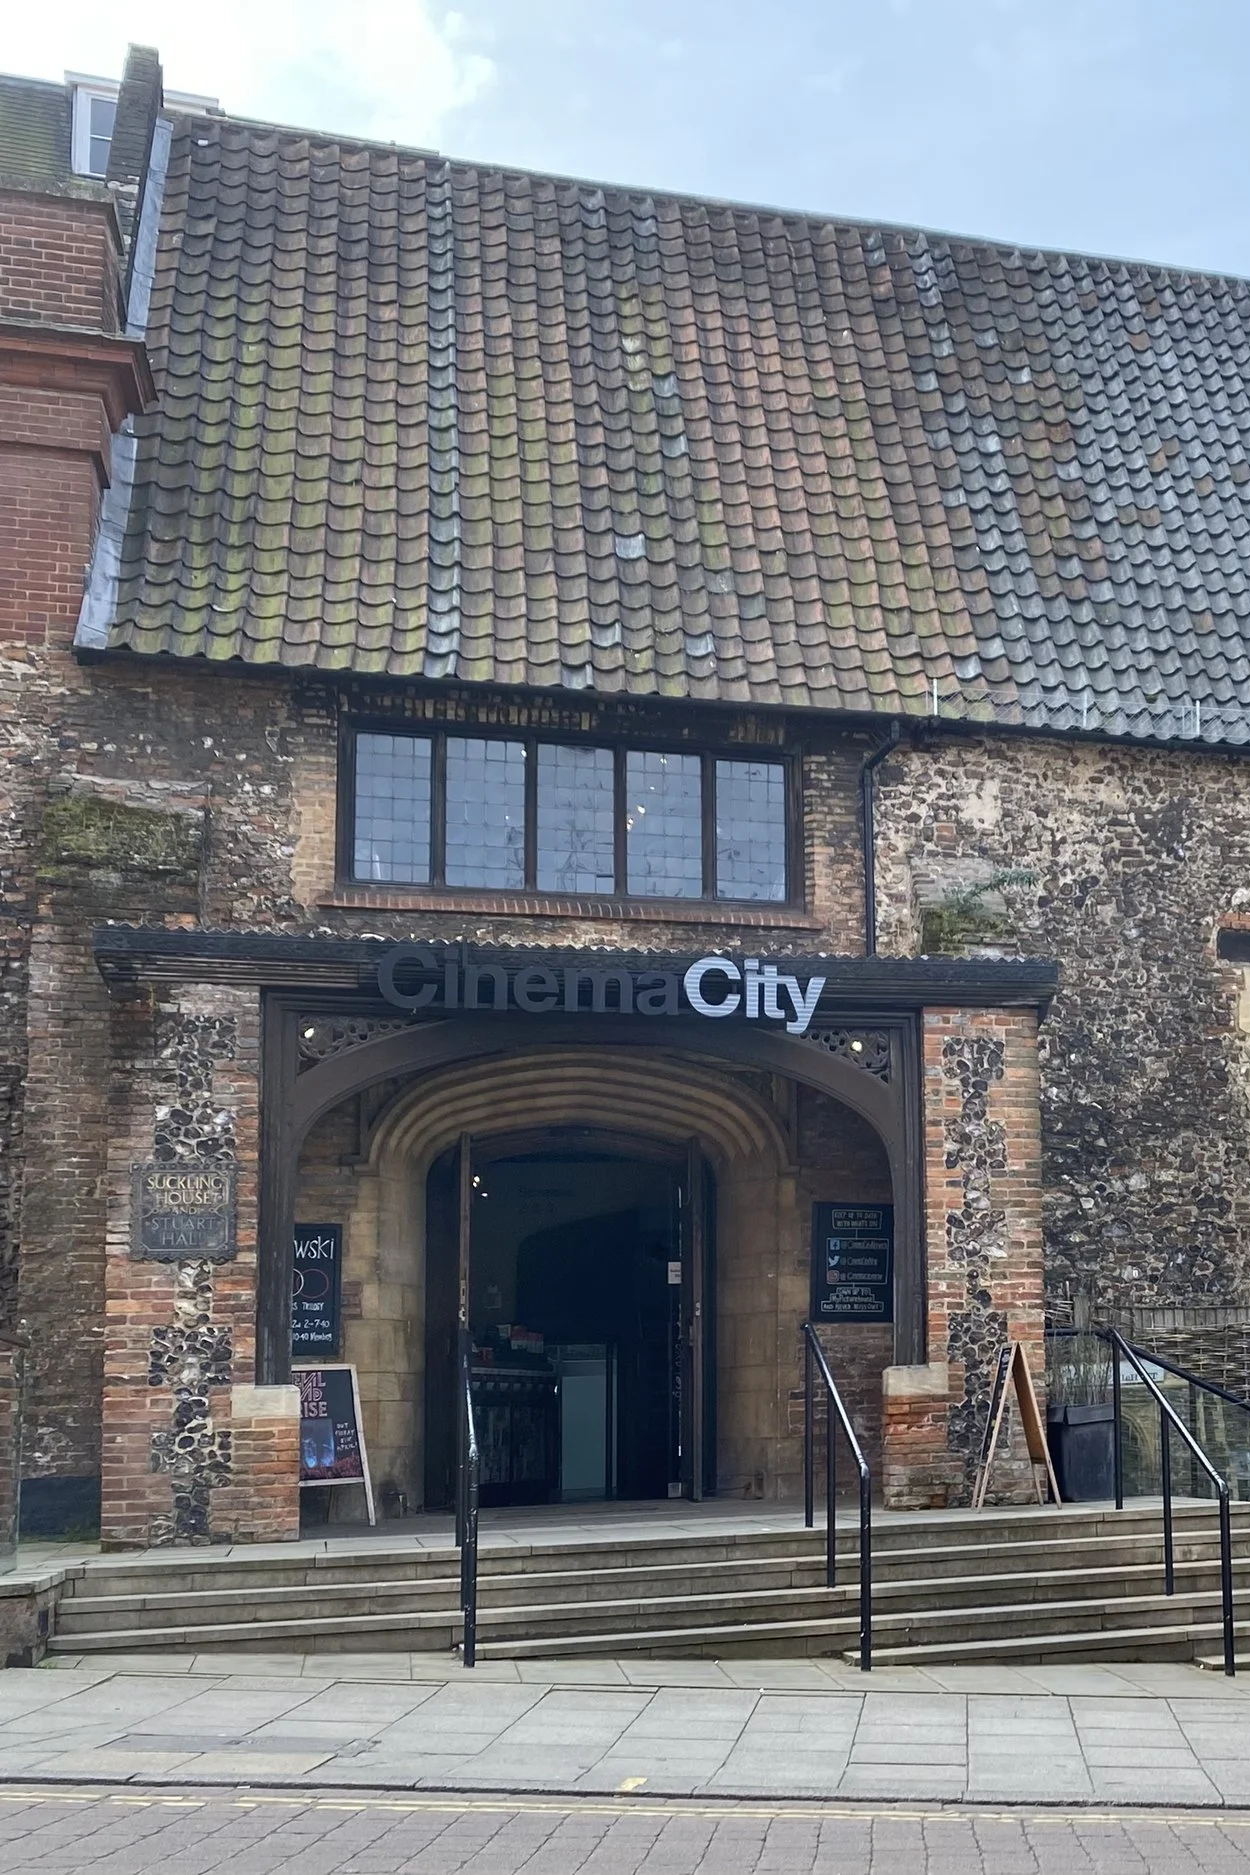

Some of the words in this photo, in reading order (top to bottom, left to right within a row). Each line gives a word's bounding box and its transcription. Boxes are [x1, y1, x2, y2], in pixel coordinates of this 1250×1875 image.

[147, 1176, 222, 1190] SUCKLING
[156, 1191, 212, 1205] HOUSE
[151, 1217, 217, 1231] STUART
[162, 1231, 205, 1246] HALL
[293, 1236, 335, 1260] wski
[299, 1401, 328, 1418] ISE
